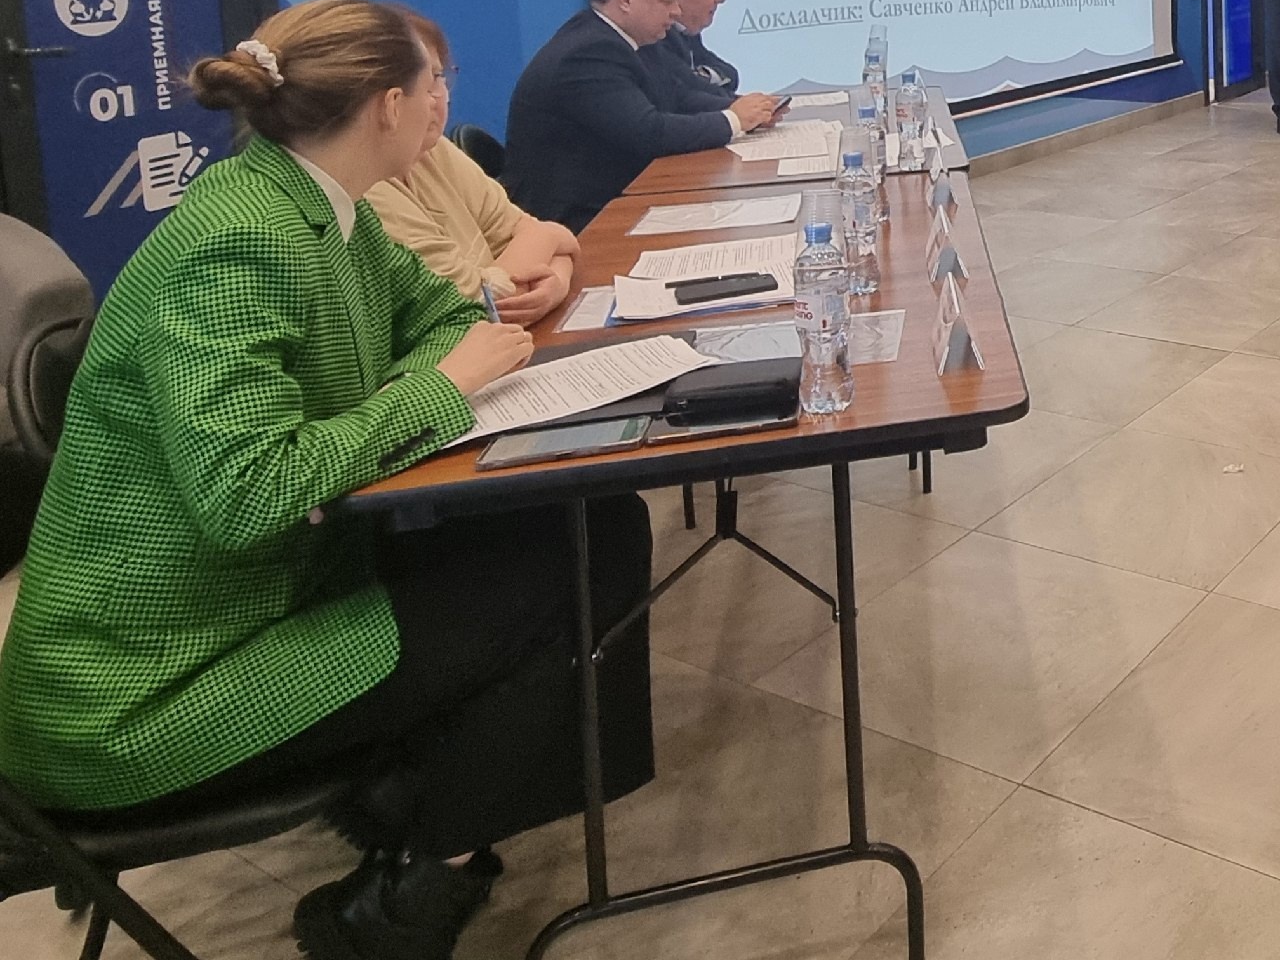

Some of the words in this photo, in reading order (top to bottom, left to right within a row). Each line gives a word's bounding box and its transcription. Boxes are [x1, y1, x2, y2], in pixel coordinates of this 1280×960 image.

[738, 3, 863, 34] Докладчик:
[148, 0, 172, 111] ПРИЕМНАЯ
[89, 84, 136, 122] 01
